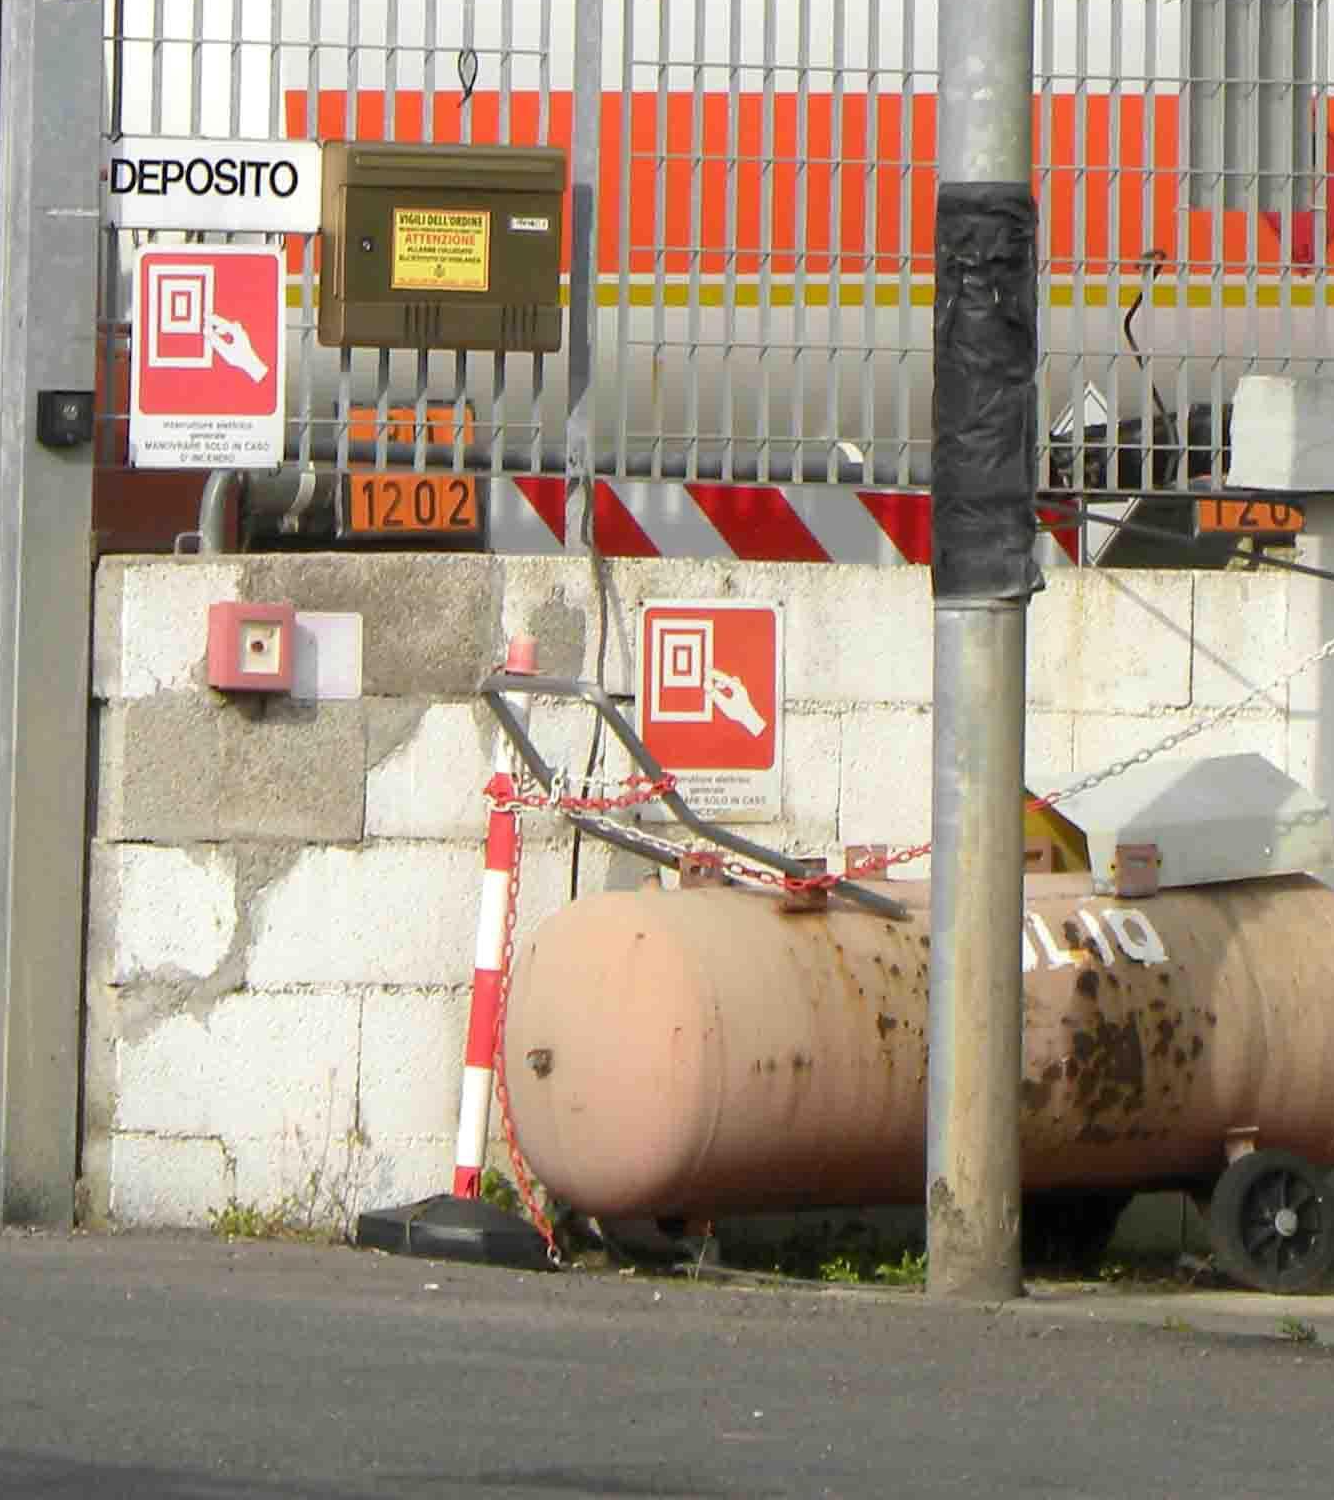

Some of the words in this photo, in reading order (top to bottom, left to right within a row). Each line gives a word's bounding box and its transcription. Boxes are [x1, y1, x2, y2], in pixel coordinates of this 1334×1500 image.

[110, 157, 298, 197] DEPOSITO
[405, 233, 475, 246] ATTENZIONE
[362, 479, 471, 527] 1202
